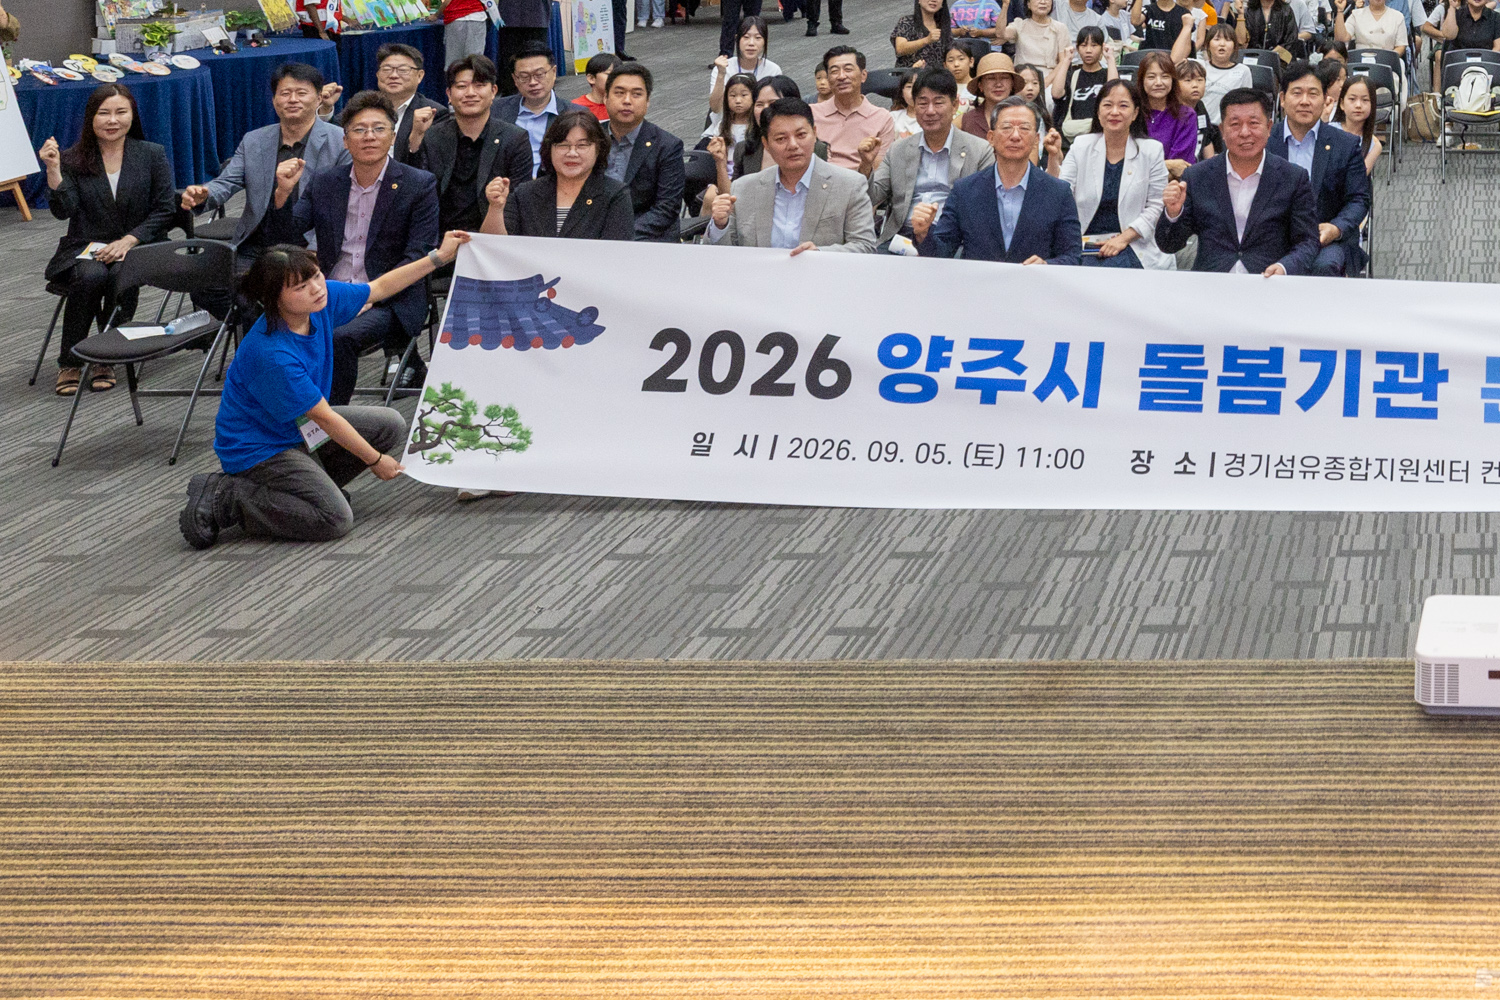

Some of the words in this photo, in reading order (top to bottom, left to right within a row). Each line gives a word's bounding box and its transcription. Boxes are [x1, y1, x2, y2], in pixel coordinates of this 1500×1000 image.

[641, 327, 852, 400] 2026
[877, 332, 1105, 409] 양주시
[1138, 343, 1449, 420] 돌봄기관
[690, 432, 715, 457] 일
[787, 437, 857, 462] 2026.
[867, 440, 904, 463] 09.
[915, 442, 952, 466] 05.
[963, 442, 1005, 470] (토)
[1017, 446, 1085, 471] 11:00
[1131, 450, 1155, 475] 장
[1224, 453, 1470, 484] 경기섬유종합지원센터
